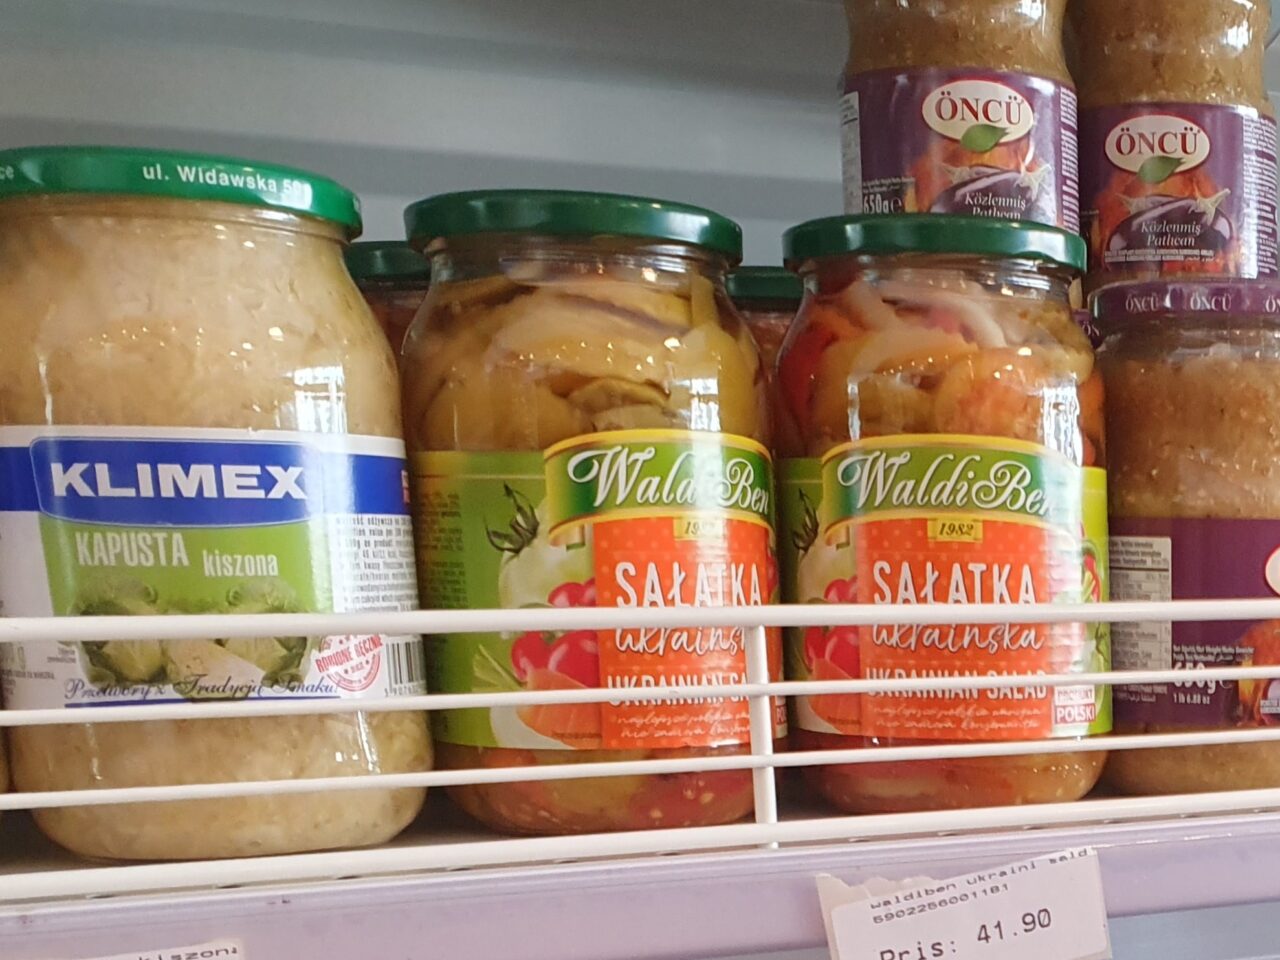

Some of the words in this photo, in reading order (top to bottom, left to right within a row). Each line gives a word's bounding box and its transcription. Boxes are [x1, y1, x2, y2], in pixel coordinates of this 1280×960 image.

[935, 90, 1025, 126] ÖNCÜ
[1115, 127, 1201, 156] ÖNCÜ
[142, 163, 169, 181] ul.
[177, 165, 277, 193] Widawska
[965, 192, 1026, 211] Közlenmiş
[1125, 296, 1159, 312] ÖNCÜ
[1190, 296, 1232, 312] ÖNCÜ
[50, 463, 308, 500] KLIMEX
[938, 521, 975, 537] 1982
[75, 532, 189, 567] KAPUSTA
[202, 549, 279, 577] kiszona
[615, 561, 763, 608] SAŁATKA
[873, 560, 1038, 606] SAŁATKA
[1056, 705, 1096, 722] POLSKI
[870, 882, 958, 911] waldiben
[967, 861, 1037, 886] ukraini
[977, 908, 1052, 944] 41.90
